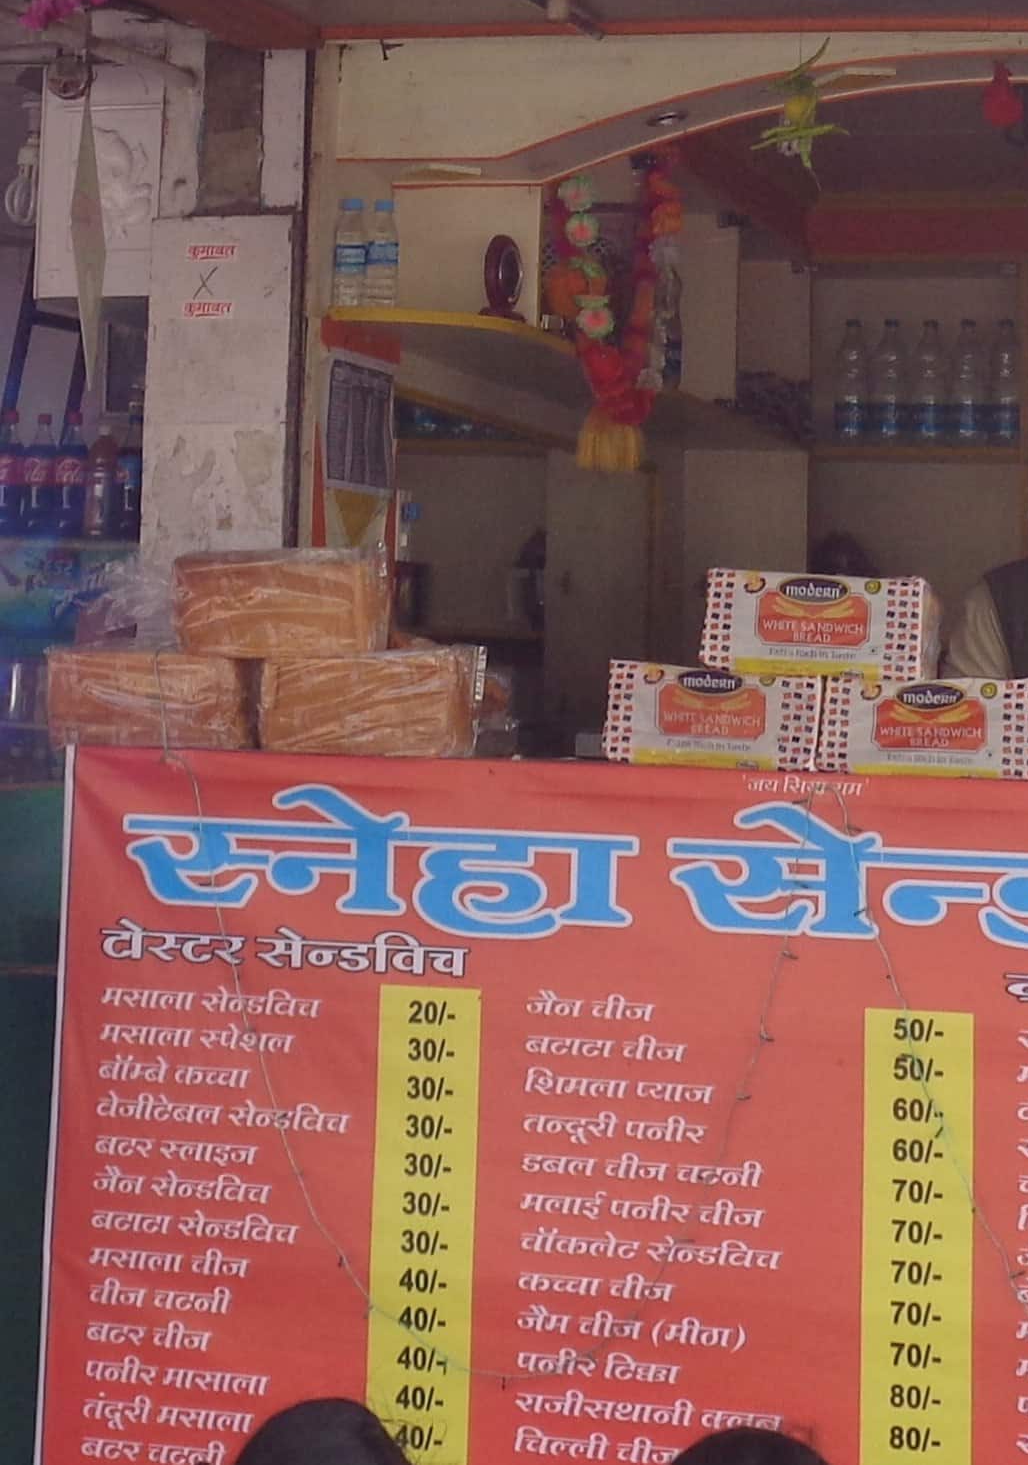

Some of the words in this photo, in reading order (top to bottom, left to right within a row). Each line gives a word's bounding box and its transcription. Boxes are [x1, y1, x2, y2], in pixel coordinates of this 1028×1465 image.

[762, 619, 798, 631] WHITE
[801, 622, 864, 634] SANDWICH
[793, 633, 831, 643] BREAD
[124, 783, 639, 940] स्नेहा
[101, 918, 244, 964] टोस्टर
[256, 926, 468, 977] सेन्डविच
[101, 987, 194, 1010] मसाला
[201, 986, 321, 1018] सेन्डविच
[409, 1000, 455, 1025] 20/-
[526, 990, 582, 1018] जैन
[592, 994, 655, 1022] चीज
[100, 1023, 192, 1048] मसाला
[200, 1023, 295, 1054] स्पेशल
[893, 1019, 944, 1042] 50/-
[408, 1039, 454, 1063] 30/-
[525, 1035, 614, 1058] बटाटा
[623, 1034, 687, 1063] चीज
[175, 1065, 250, 1088] कच्चा
[893, 1056, 944, 1082] 50/-
[407, 1076, 453, 1101] 30/-
[525, 1067, 628, 1098] शिमला
[637, 1080, 715, 1104] प्याज
[228, 1100, 351, 1134] सेन्डविच
[893, 1098, 944, 1123] 60/-
[405, 1115, 452, 1140] 30/-
[523, 1111, 617, 1143] तन्दूरी
[626, 1115, 706, 1143] पनीर
[95, 1135, 153, 1158] बटर
[160, 1140, 258, 1166] स्लाइज
[892, 1139, 944, 1164] 60/-
[404, 1153, 451, 1178] 30/-
[520, 1153, 595, 1176] डबल
[605, 1151, 669, 1182] चीज
[677, 1162, 763, 1188] चटनी
[93, 1166, 144, 1195] जैन
[151, 1170, 272, 1204] सेन्डविच
[892, 1179, 943, 1204] 70/-
[402, 1192, 450, 1217] 30/-
[520, 1191, 606, 1218] मलाई
[610, 1194, 691, 1223] पनीर
[699, 1199, 765, 1228] चीज
[91, 1210, 170, 1234] बटाटा
[178, 1211, 298, 1245] सेन्डविच
[892, 1220, 942, 1245] 70/-
[401, 1230, 448, 1255] 30/-
[647, 1234, 783, 1269] सेन्डविच
[90, 1247, 182, 1272] मसाला
[191, 1248, 251, 1278] चीज
[891, 1261, 942, 1286] 70/-
[400, 1269, 447, 1293] 40/-
[518, 1271, 603, 1297] कच्चा
[609, 1271, 675, 1303] चीज
[90, 1277, 147, 1309] चीज
[152, 1287, 233, 1315] चटनी
[399, 1306, 446, 1331] 40/-
[890, 1301, 941, 1326] 70/-
[86, 1322, 146, 1343] बटर
[152, 1320, 213, 1351] चीज
[517, 1304, 570, 1334] जैम
[579, 1310, 640, 1341] चीज
[651, 1316, 747, 1352] (मीठा)
[397, 1347, 446, 1372] 40/-
[517, 1348, 596, 1377] पनीर
[890, 1342, 941, 1368] 70/-
[86, 1355, 159, 1388] पनीर
[163, 1369, 270, 1396] मासाला
[396, 1385, 444, 1410] 40/-
[890, 1385, 941, 1410] 80/-
[83, 1392, 151, 1430] तंदूरी
[156, 1407, 256, 1433] मसाला
[80, 1437, 142, 1461] बटर
[514, 1426, 608, 1461] चिल्ली
[889, 1426, 940, 1452] 80/-
